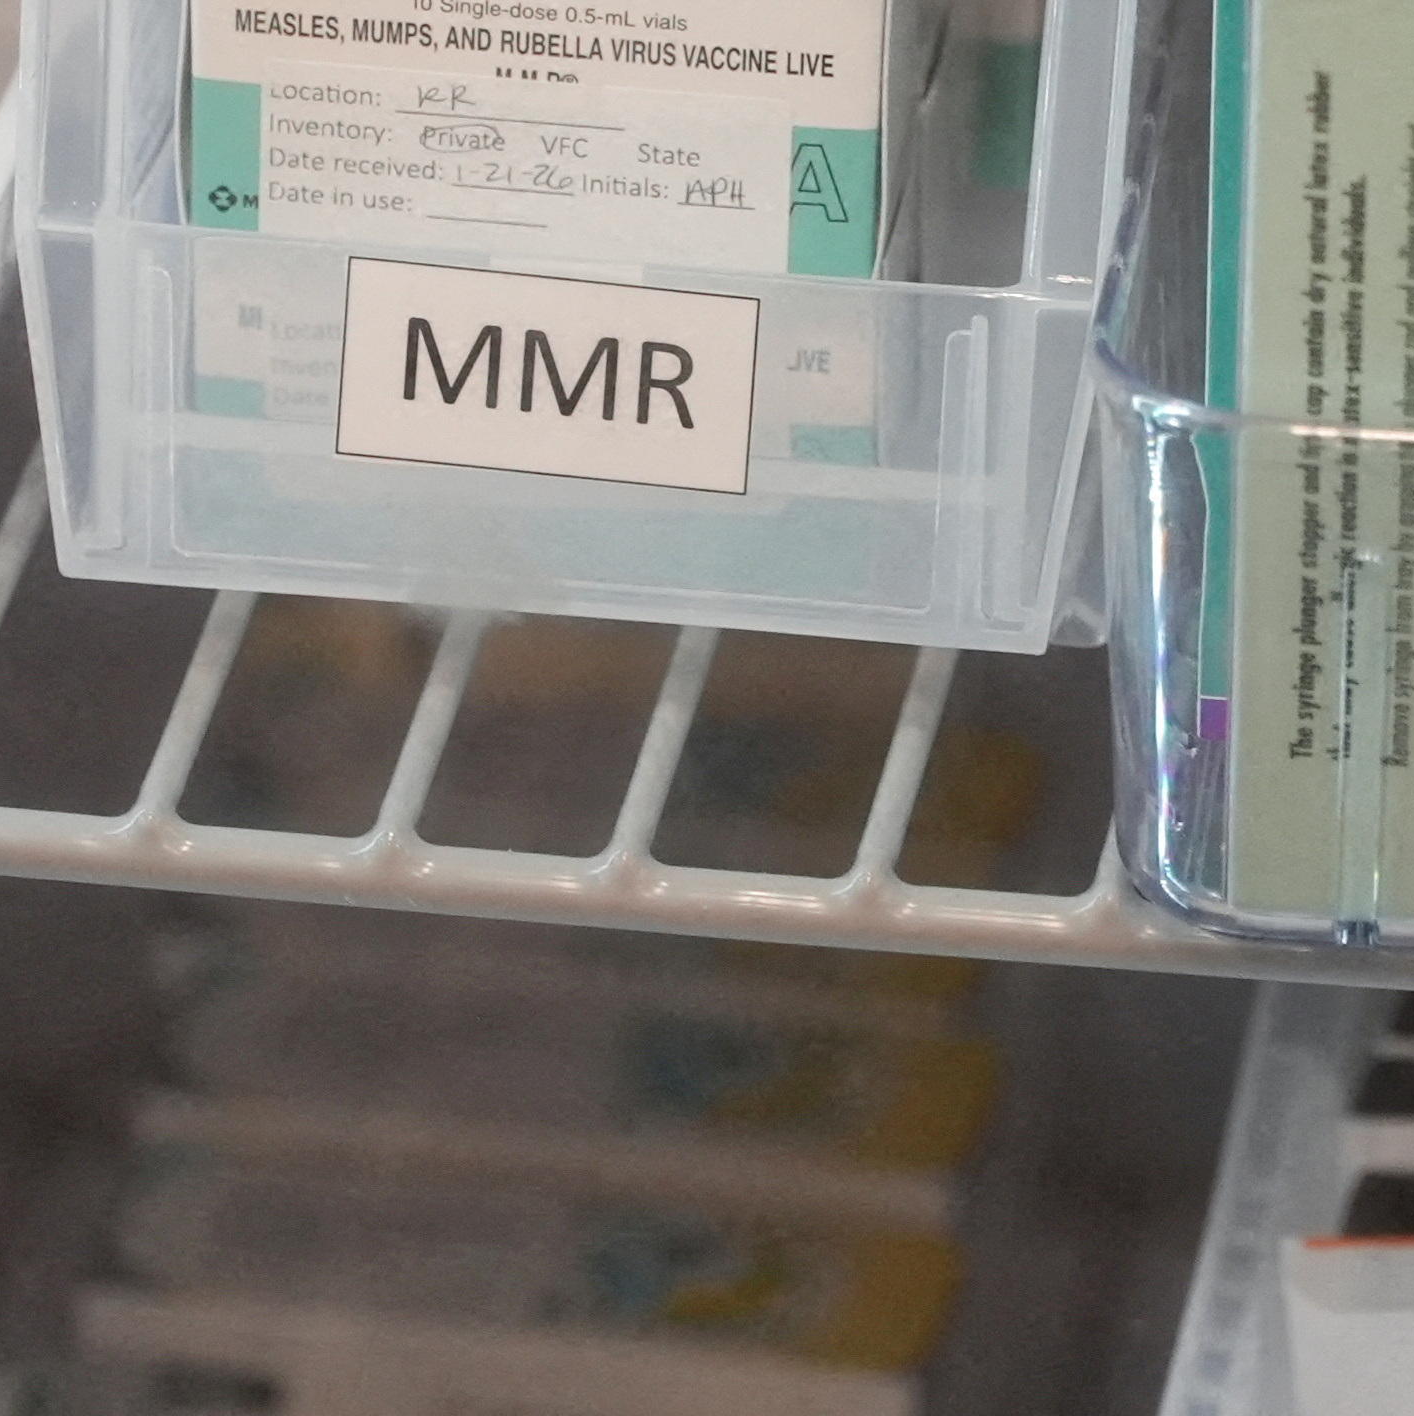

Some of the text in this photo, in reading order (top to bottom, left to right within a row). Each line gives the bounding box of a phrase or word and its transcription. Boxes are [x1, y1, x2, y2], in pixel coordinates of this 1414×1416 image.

[236, 8, 835, 78] MEASLES, MUMPS, AND RUBELLA VIRUS VACCINE LIVE
[565, 6, 636, 29] 0.5-mL
[643, 12, 688, 32] vials
[270, 84, 382, 108] Location:
[269, 113, 701, 168] Inventory: Private VFC State
[268, 182, 326, 205] Date
[333, 187, 354, 209] in
[363, 194, 414, 213] use:
[269, 147, 326, 172] Date
[333, 157, 444, 182] received:
[582, 173, 670, 200] Initials:
[403, 315, 696, 431] MMR
